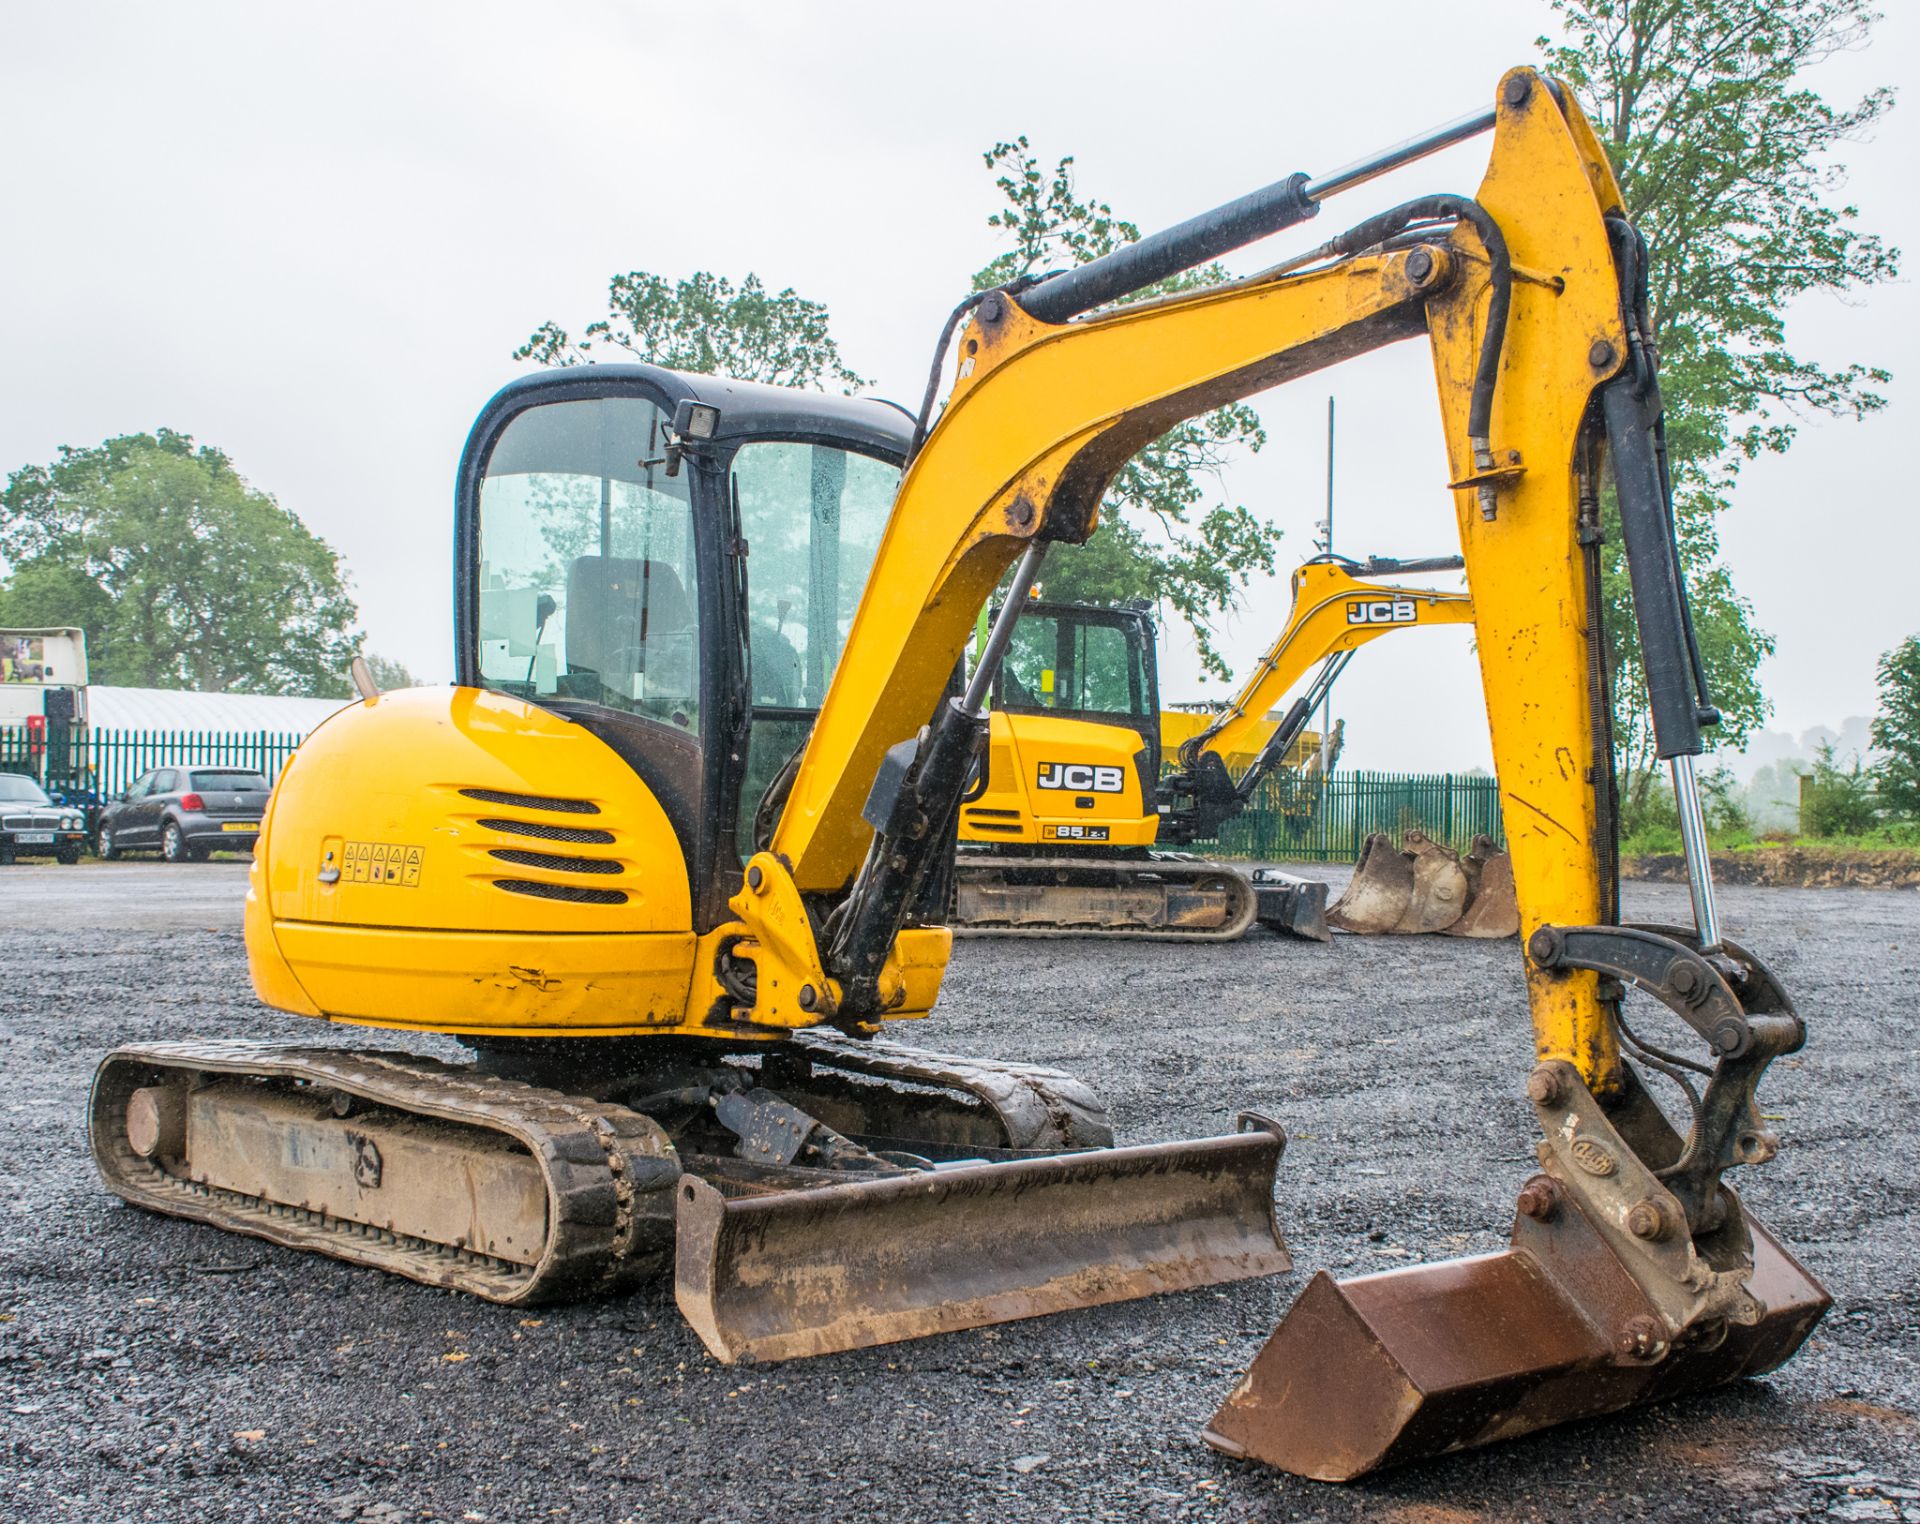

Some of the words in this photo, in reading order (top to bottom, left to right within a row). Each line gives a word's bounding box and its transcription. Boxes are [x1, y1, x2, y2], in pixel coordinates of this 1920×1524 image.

[1348, 602, 1416, 623] JCB
[1039, 765, 1122, 792] JCB
[1057, 826, 1084, 837] 85
